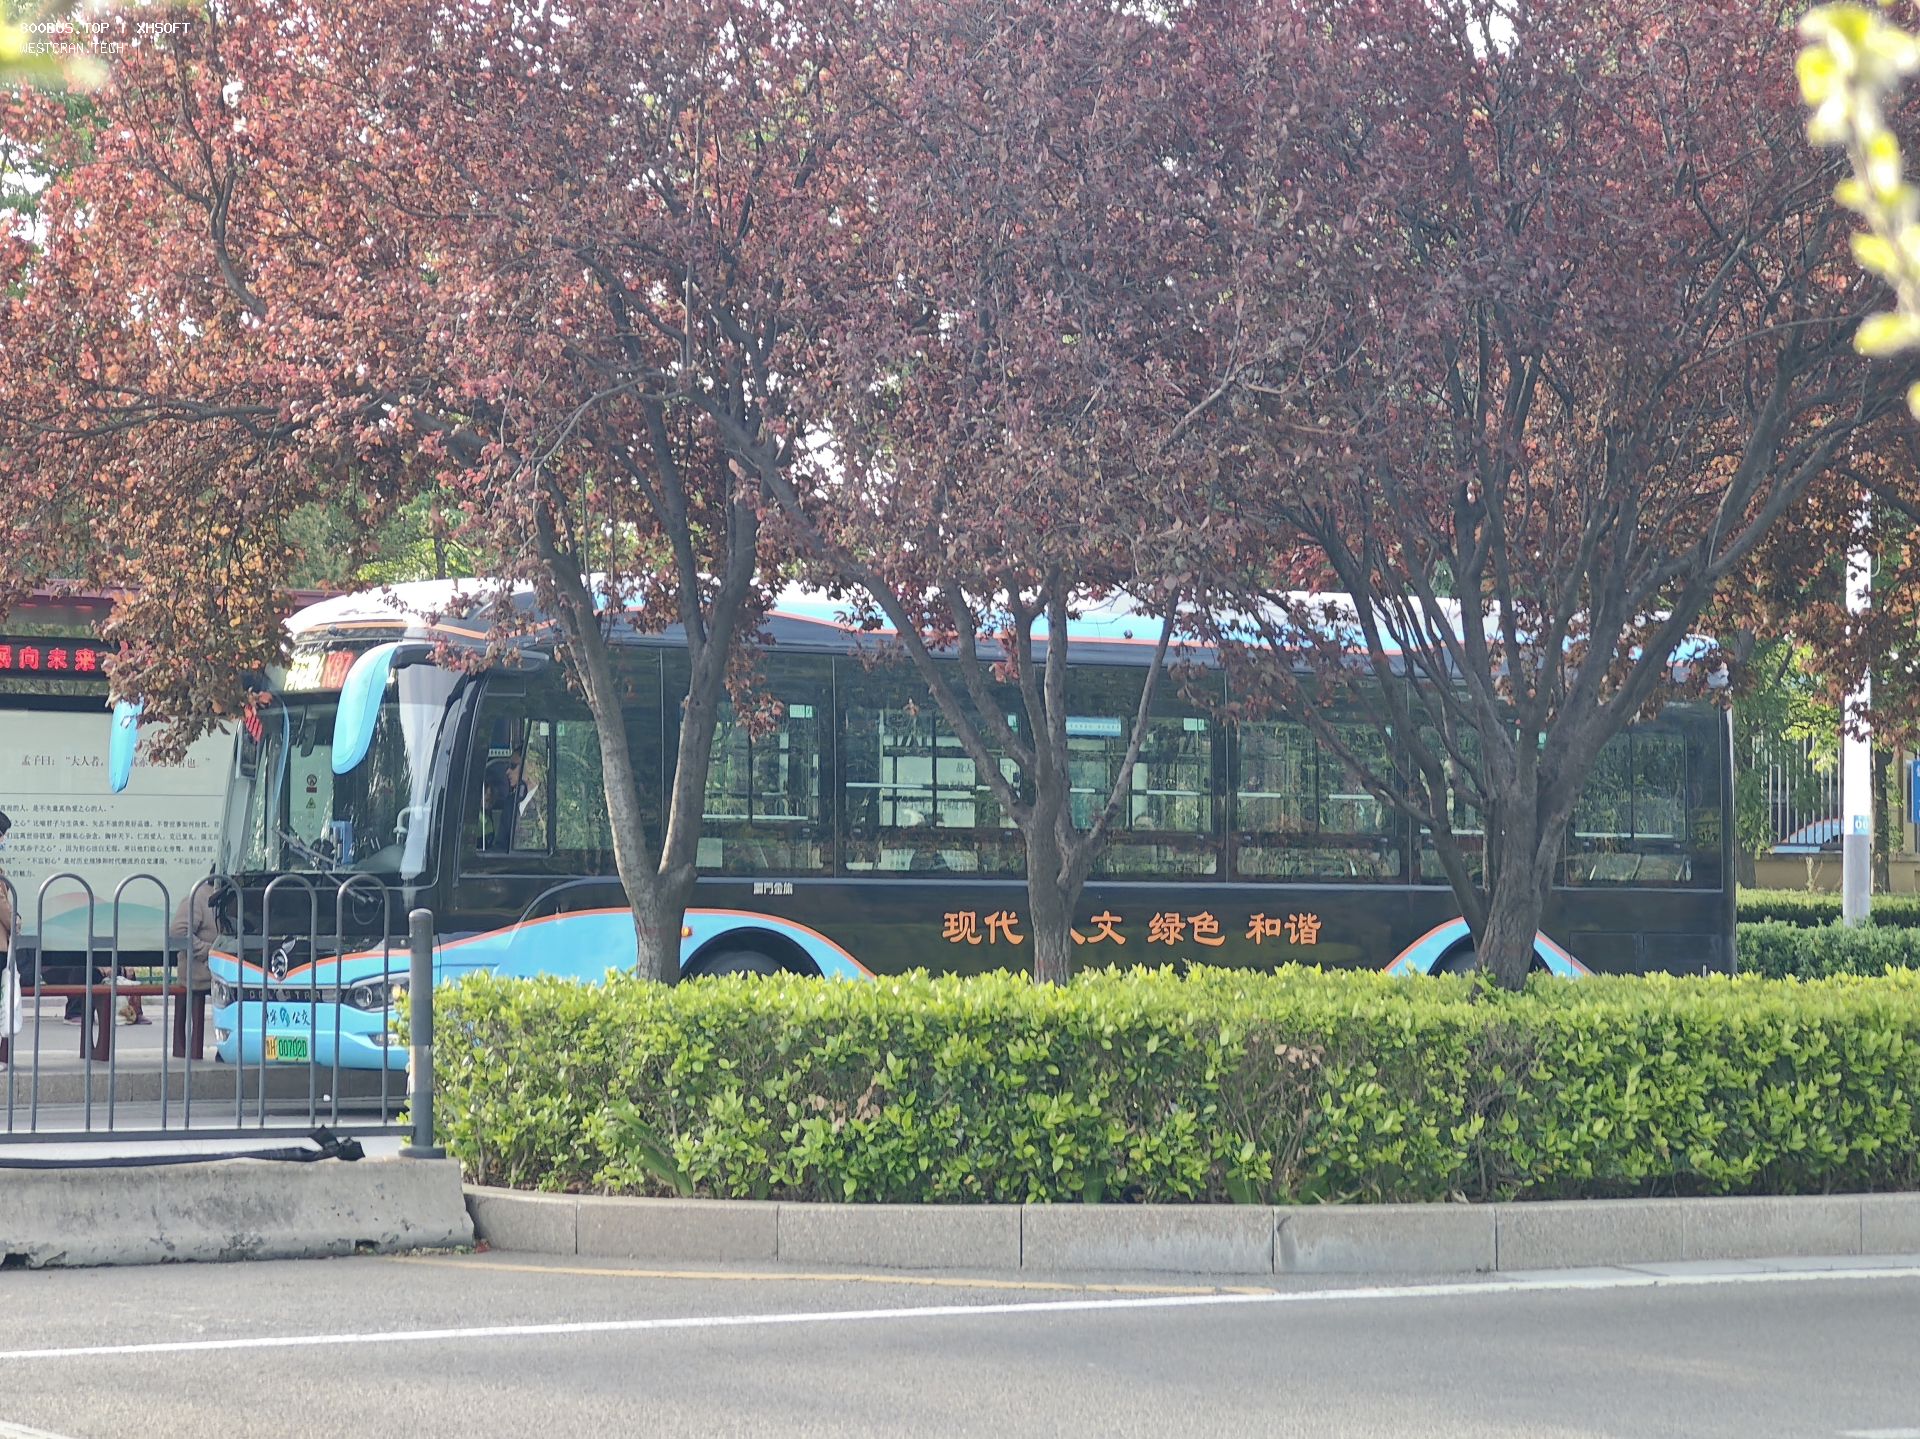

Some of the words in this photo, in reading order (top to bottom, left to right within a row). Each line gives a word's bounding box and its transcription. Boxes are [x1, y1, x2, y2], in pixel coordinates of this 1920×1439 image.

[942, 910, 1024, 945] 现代
[1147, 910, 1226, 946] 绿色
[1245, 911, 1322, 945] 和谐
